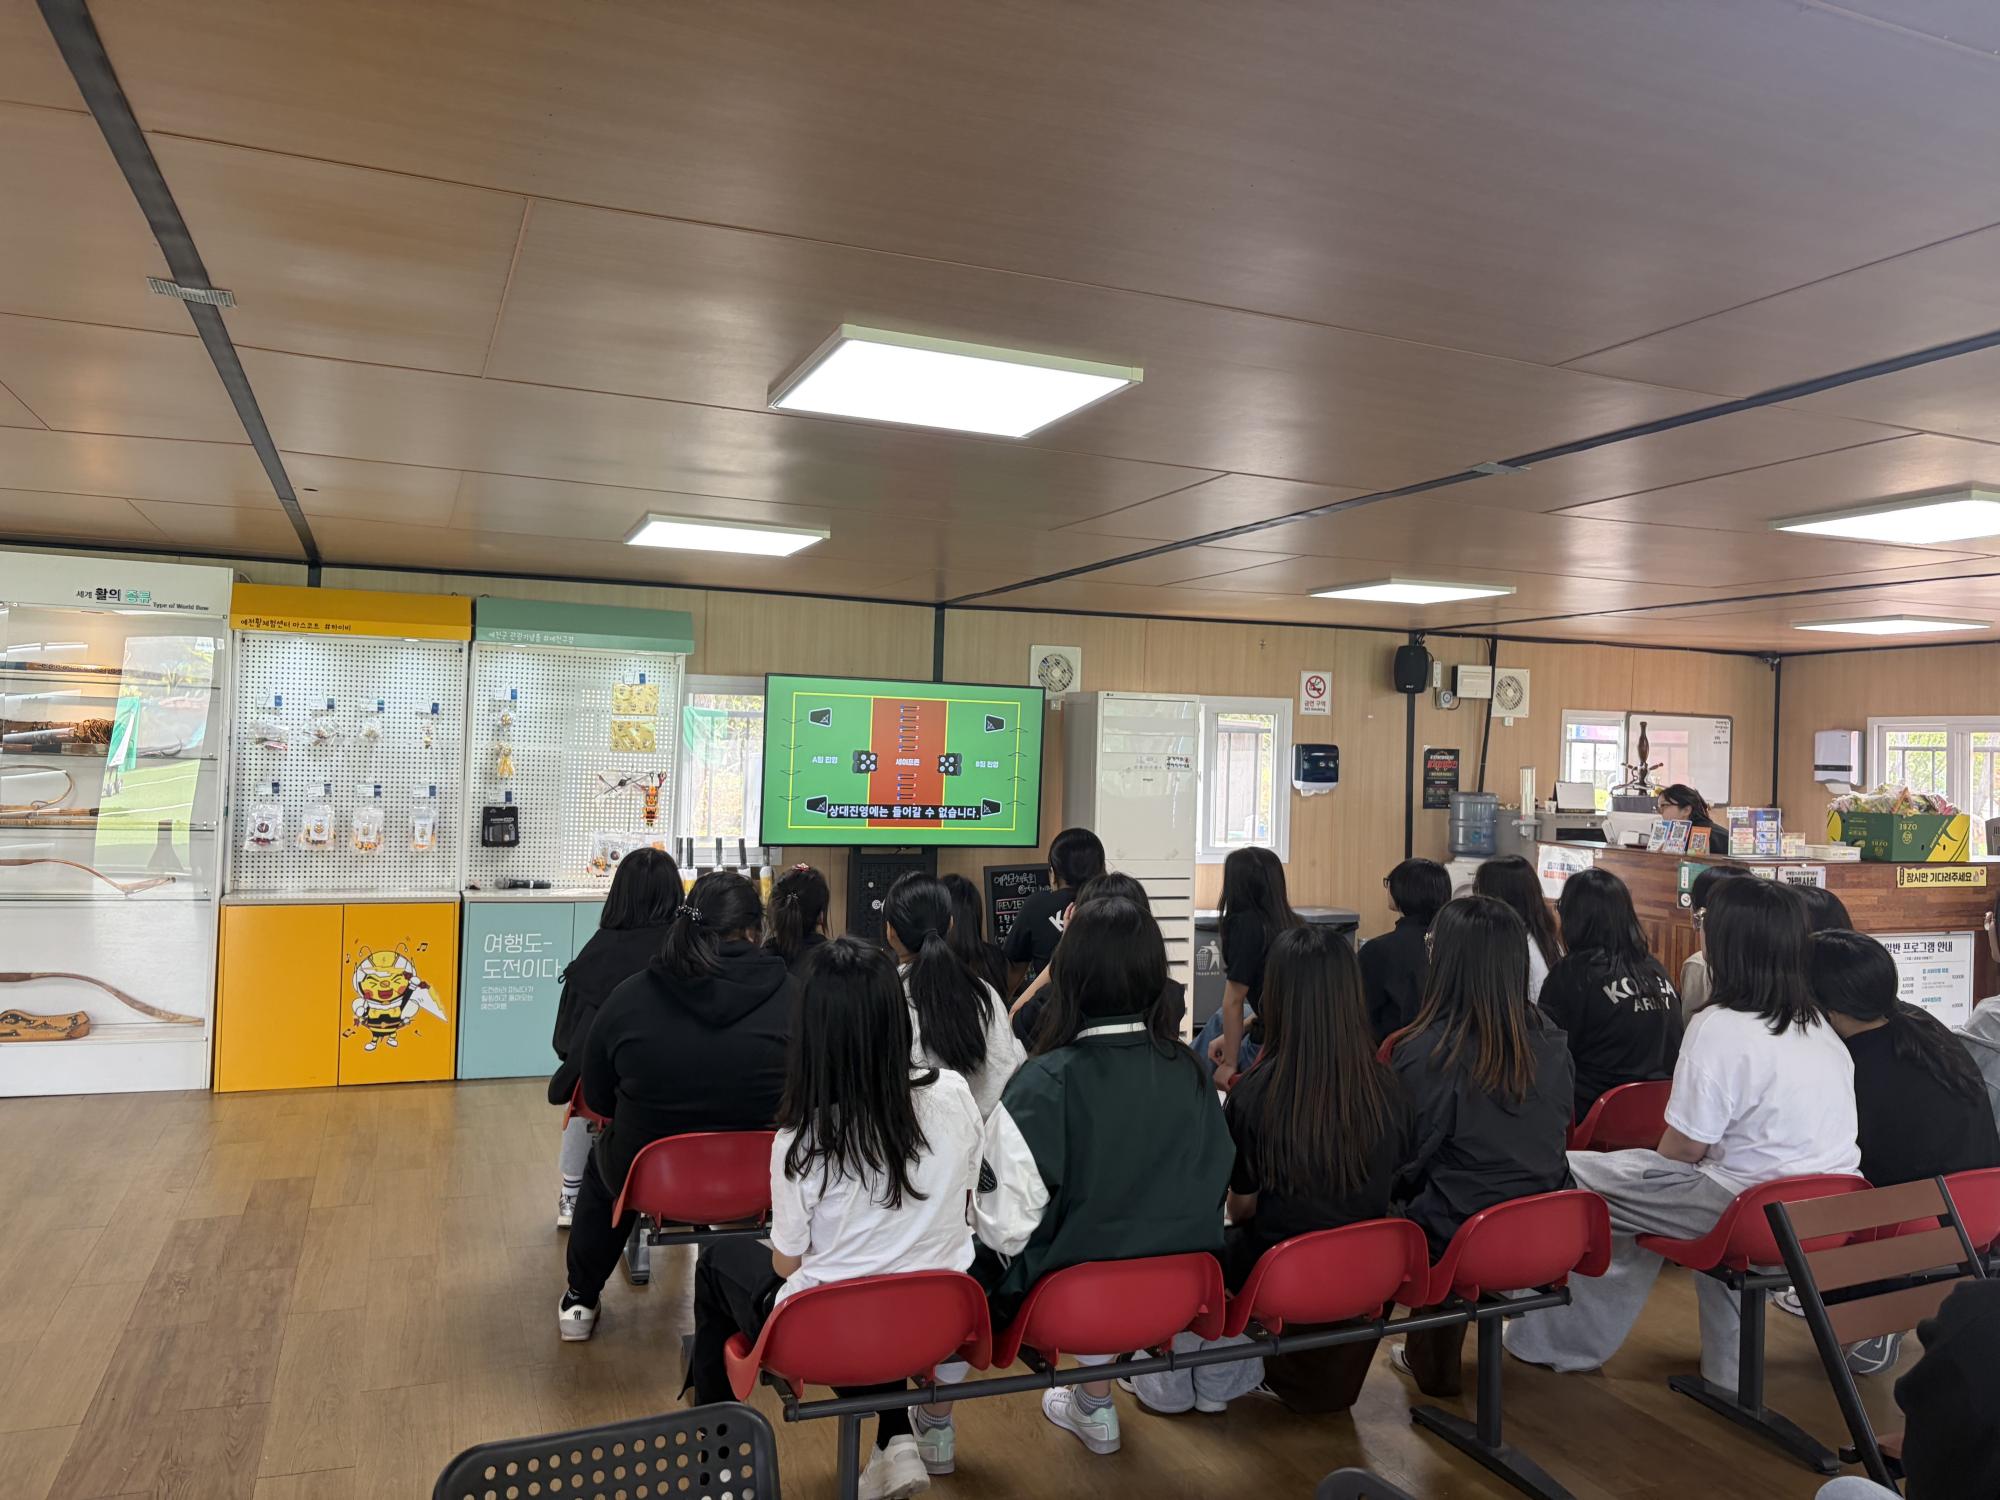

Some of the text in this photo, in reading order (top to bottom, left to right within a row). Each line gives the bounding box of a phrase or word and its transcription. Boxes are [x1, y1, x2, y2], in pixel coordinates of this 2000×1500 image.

[76, 587, 152, 604] 세계 활의 종류
[240, 617, 291, 629] 예천활체험센터
[292, 622, 321, 630] 마스코트
[829, 805, 980, 819] 상대진영에는 들어갈 수 없습니다.
[1906, 872, 1972, 883] 잠시만 기다려주세요
[1903, 941, 1935, 954] 프로그램
[1937, 941, 1953, 953] 안내
[482, 958, 562, 979] 도전이다
